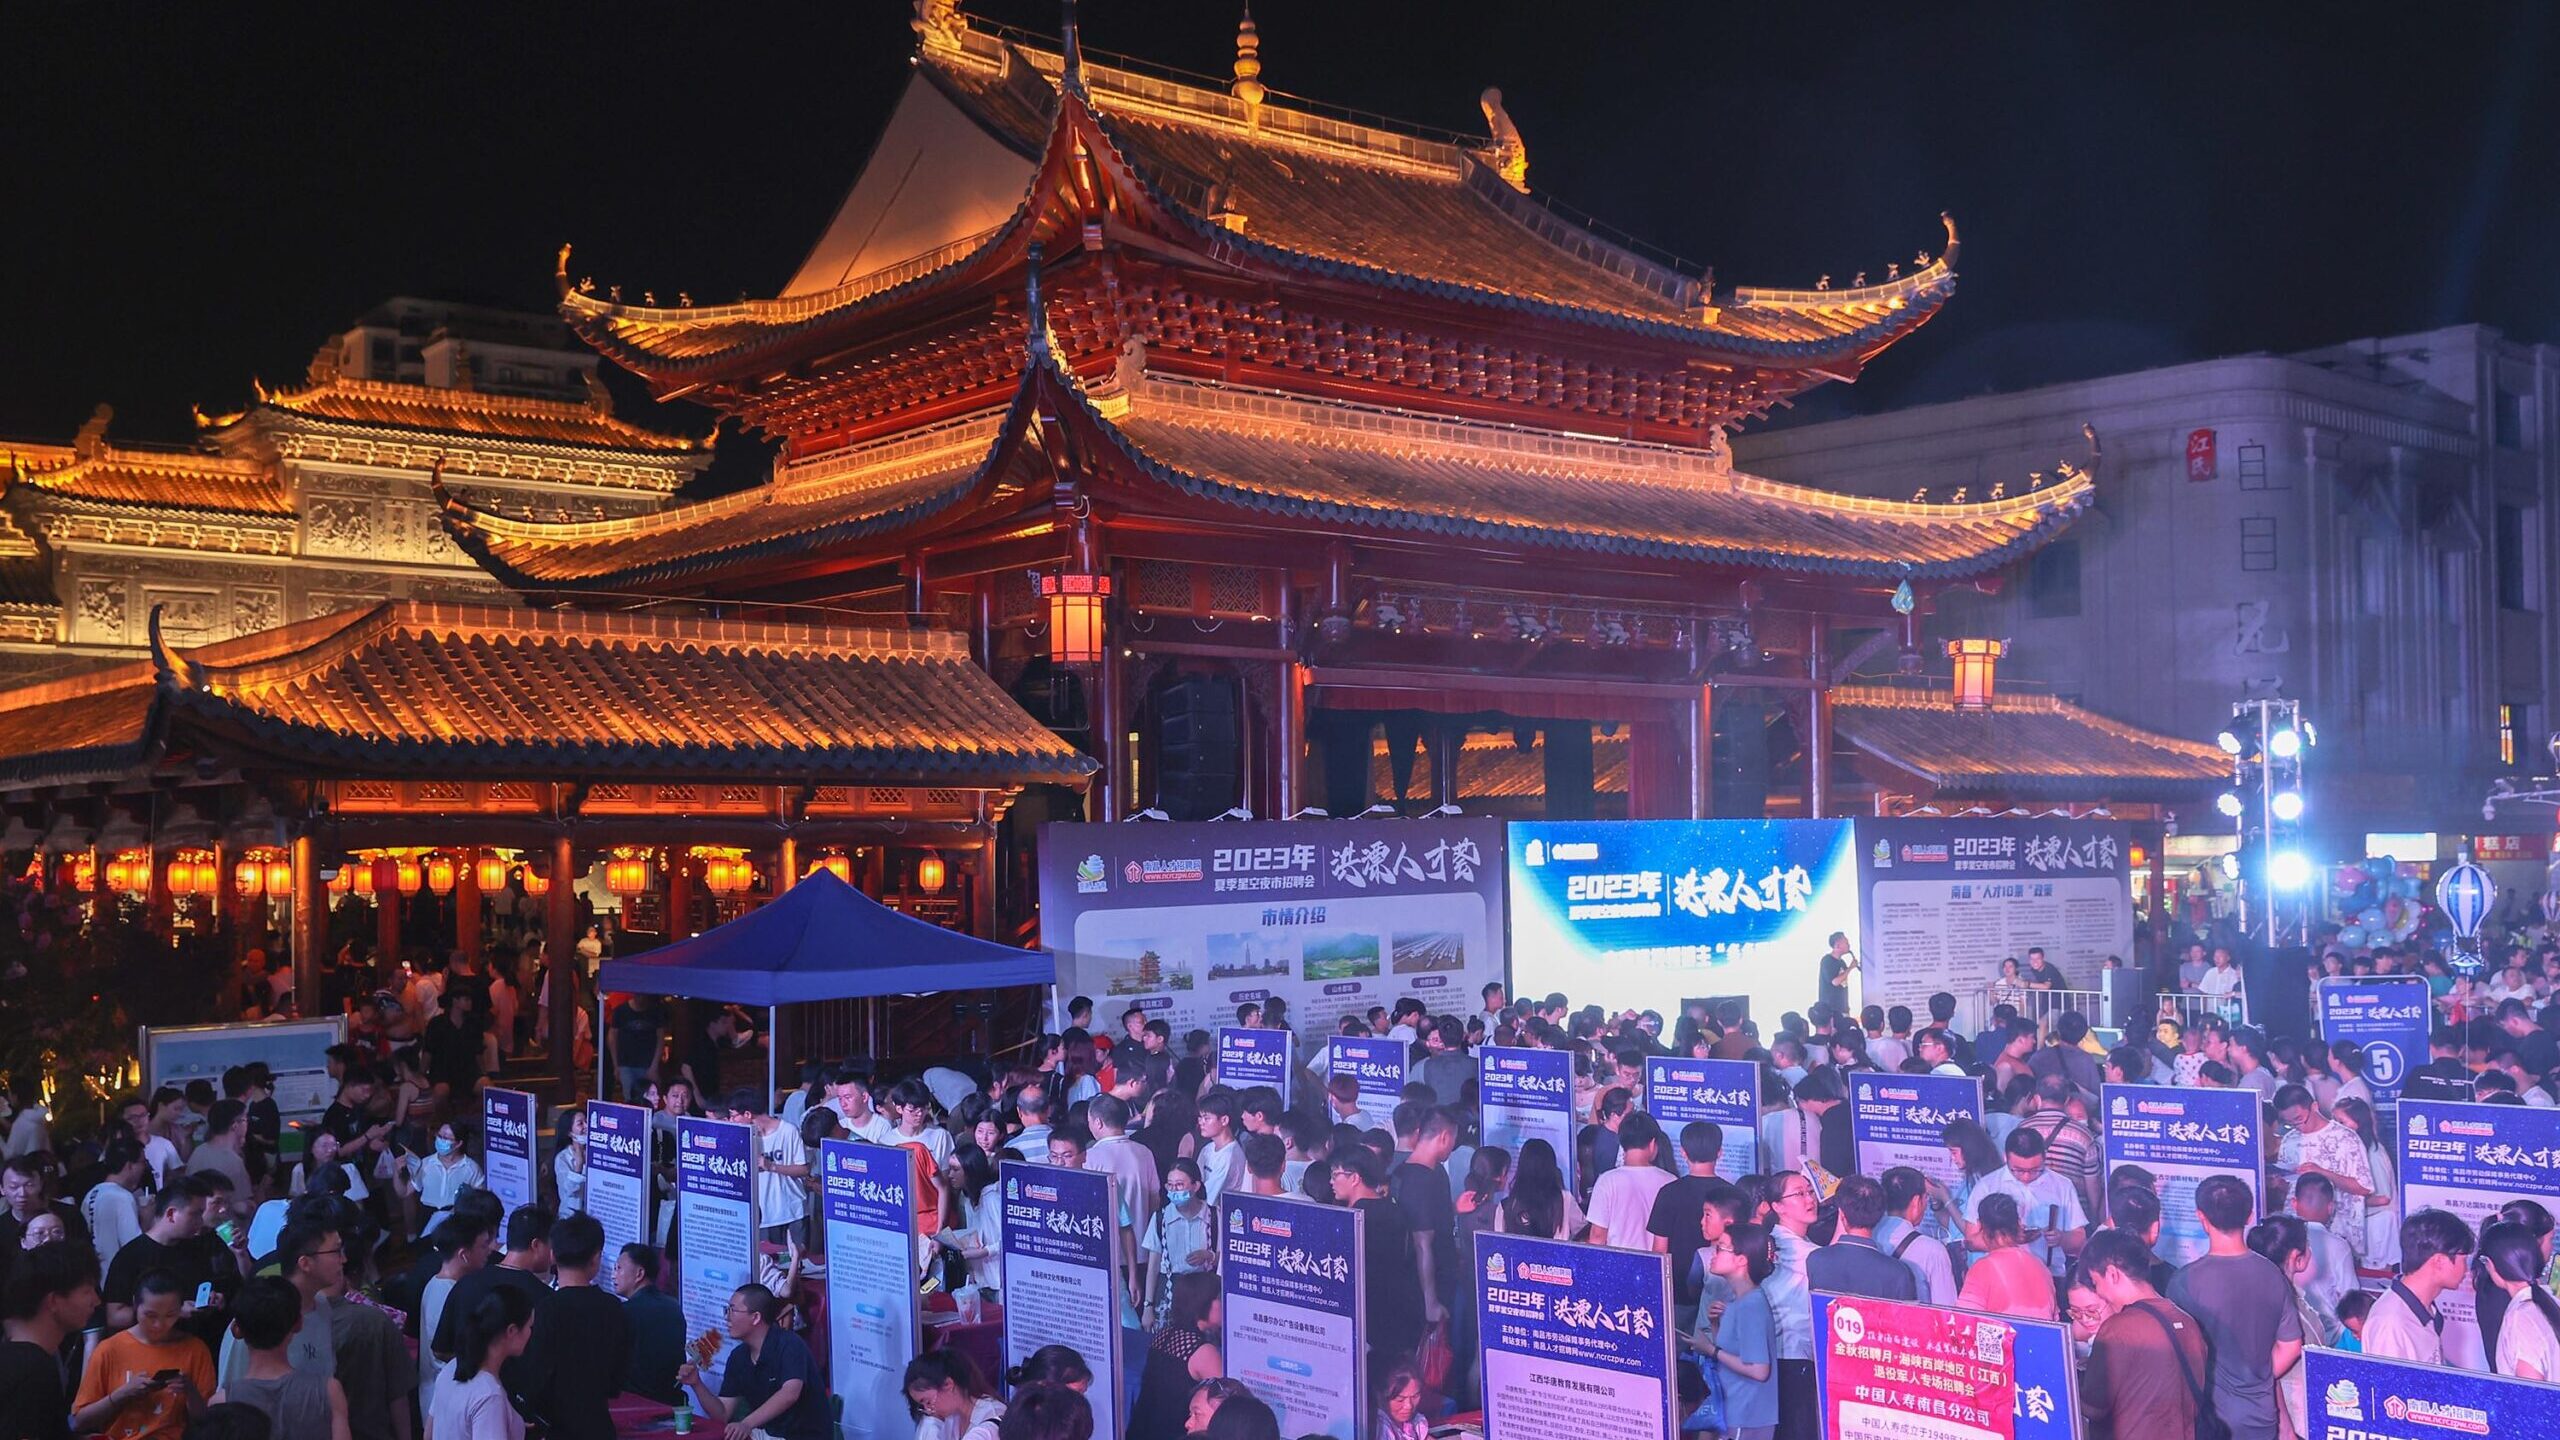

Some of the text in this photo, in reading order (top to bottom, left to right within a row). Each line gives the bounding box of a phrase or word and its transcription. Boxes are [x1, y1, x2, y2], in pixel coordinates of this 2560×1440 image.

[1954, 836, 2016, 857] 2023年
[1213, 844, 1316, 872] 2023年
[1214, 875, 1315, 892] 夏季星空夜市招聘会
[1567, 870, 1662, 900] 2023年
[1261, 906, 1326, 926] 市情介绍
[2371, 1049, 2393, 1080] 5
[1859, 1103, 1900, 1115] 2023年
[2112, 1119, 2161, 1132] 2023年
[2408, 1139, 2467, 1155] 2023年
[827, 1175, 856, 1190] 2023年
[1007, 1204, 1042, 1221] 2023年
[1229, 1239, 1272, 1259] 2023年
[1487, 1287, 1546, 1310] 2023年
[1836, 1316, 1862, 1335] 019
[1874, 1364, 1976, 1398] 退役军人专场招聘会
[1855, 1384, 1990, 1427] 中国人寿南昌分公司
[2407, 1398, 2488, 1424] 南昌人才招聘网
[2411, 1414, 2486, 1432] www.ncrczpw.com
